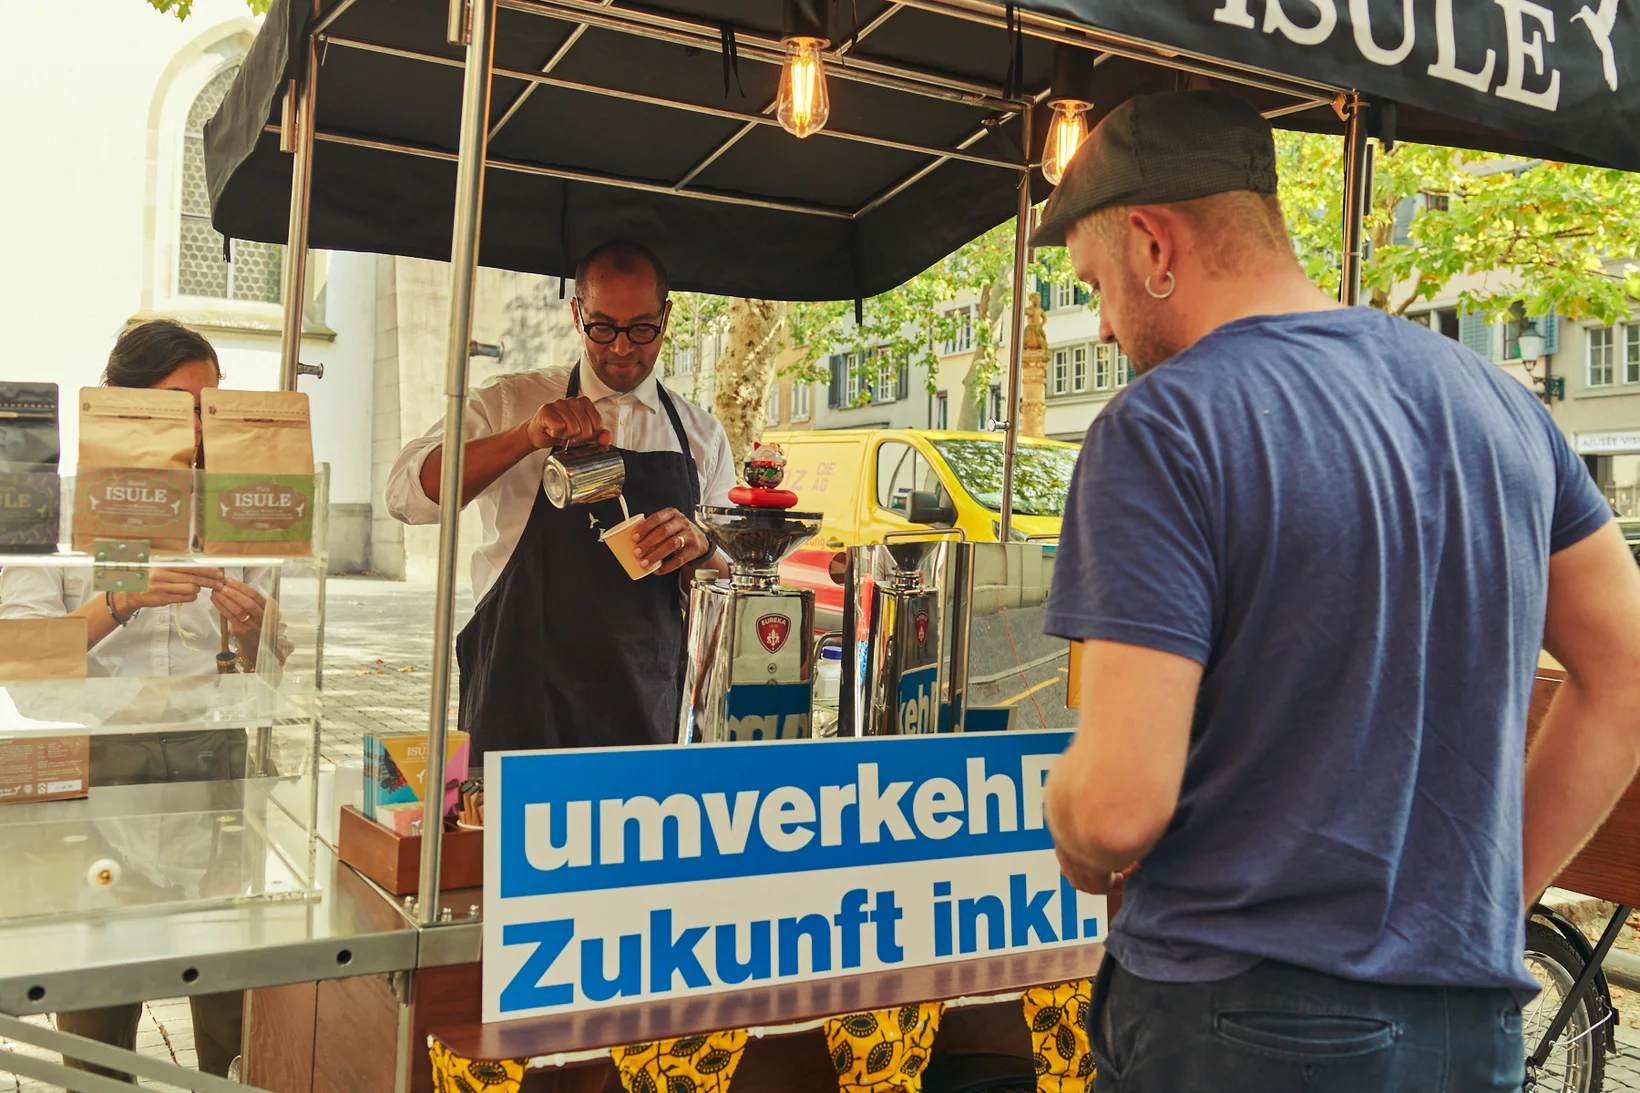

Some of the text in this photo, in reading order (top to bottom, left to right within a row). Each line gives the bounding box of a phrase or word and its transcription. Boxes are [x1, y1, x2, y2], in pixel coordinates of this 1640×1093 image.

[1213, 0, 1560, 111] ULE
[817, 462, 836, 476] CIE
[811, 479, 828, 492] AG
[104, 486, 167, 503] ISULE
[234, 493, 292, 507] ISULE
[760, 617, 786, 626] EUREKA
[407, 746, 426, 756] ISU
[500, 871, 1098, 1013] Zukunft inkl.
